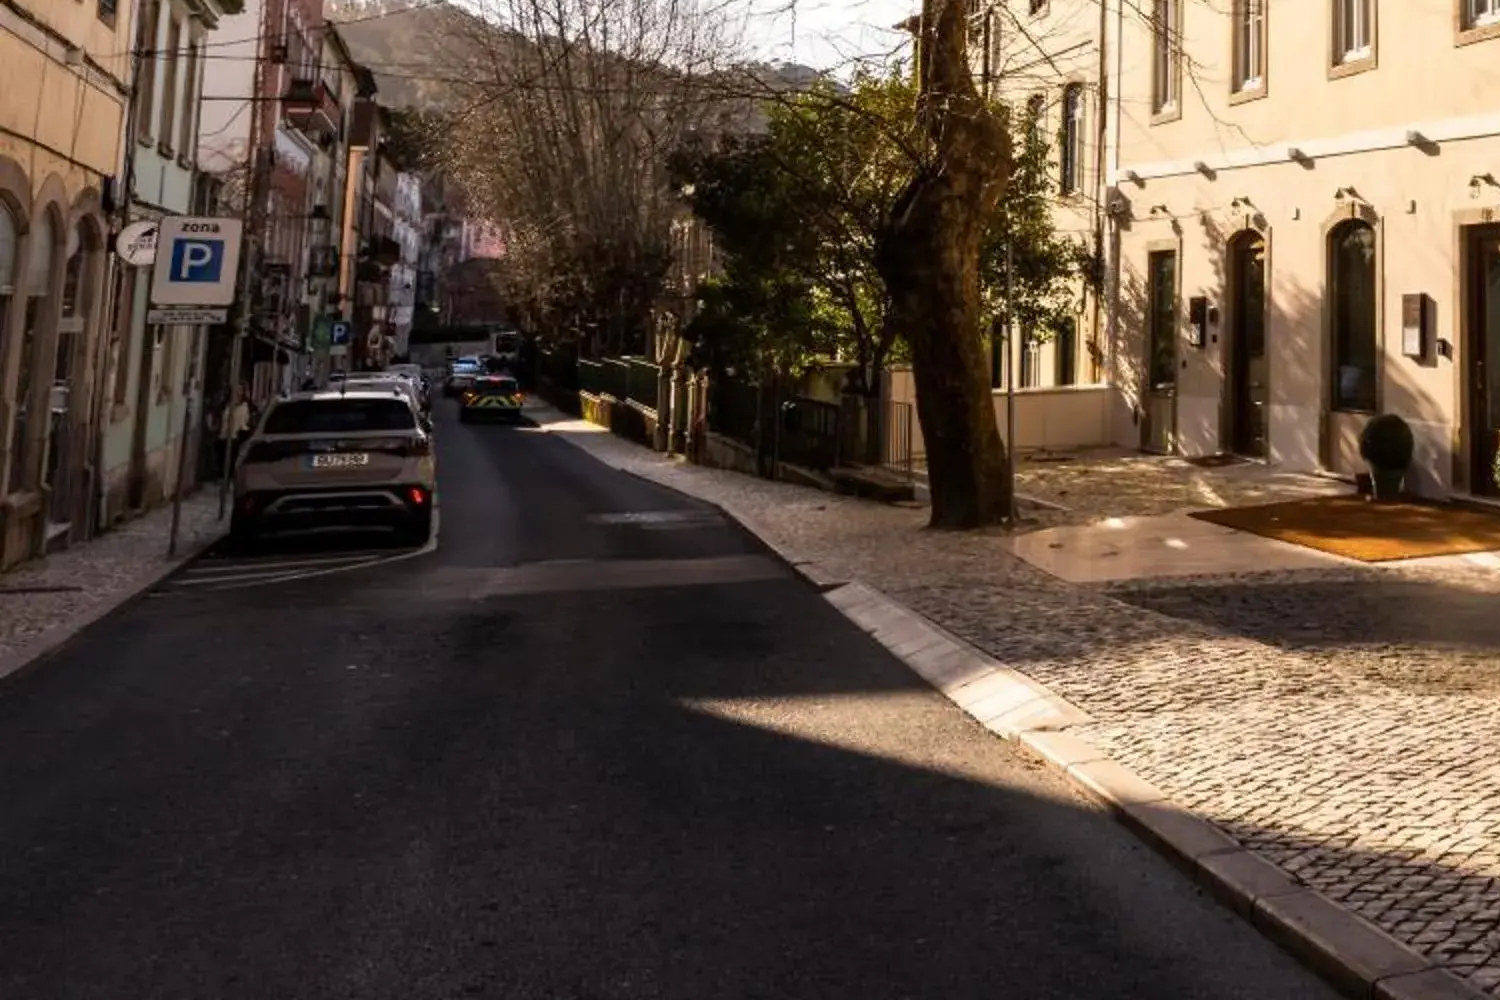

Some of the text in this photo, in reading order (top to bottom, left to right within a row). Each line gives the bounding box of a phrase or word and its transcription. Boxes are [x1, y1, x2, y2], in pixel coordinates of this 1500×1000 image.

[182, 223, 220, 233] zona
[181, 243, 213, 279] P
[333, 323, 347, 343] P
